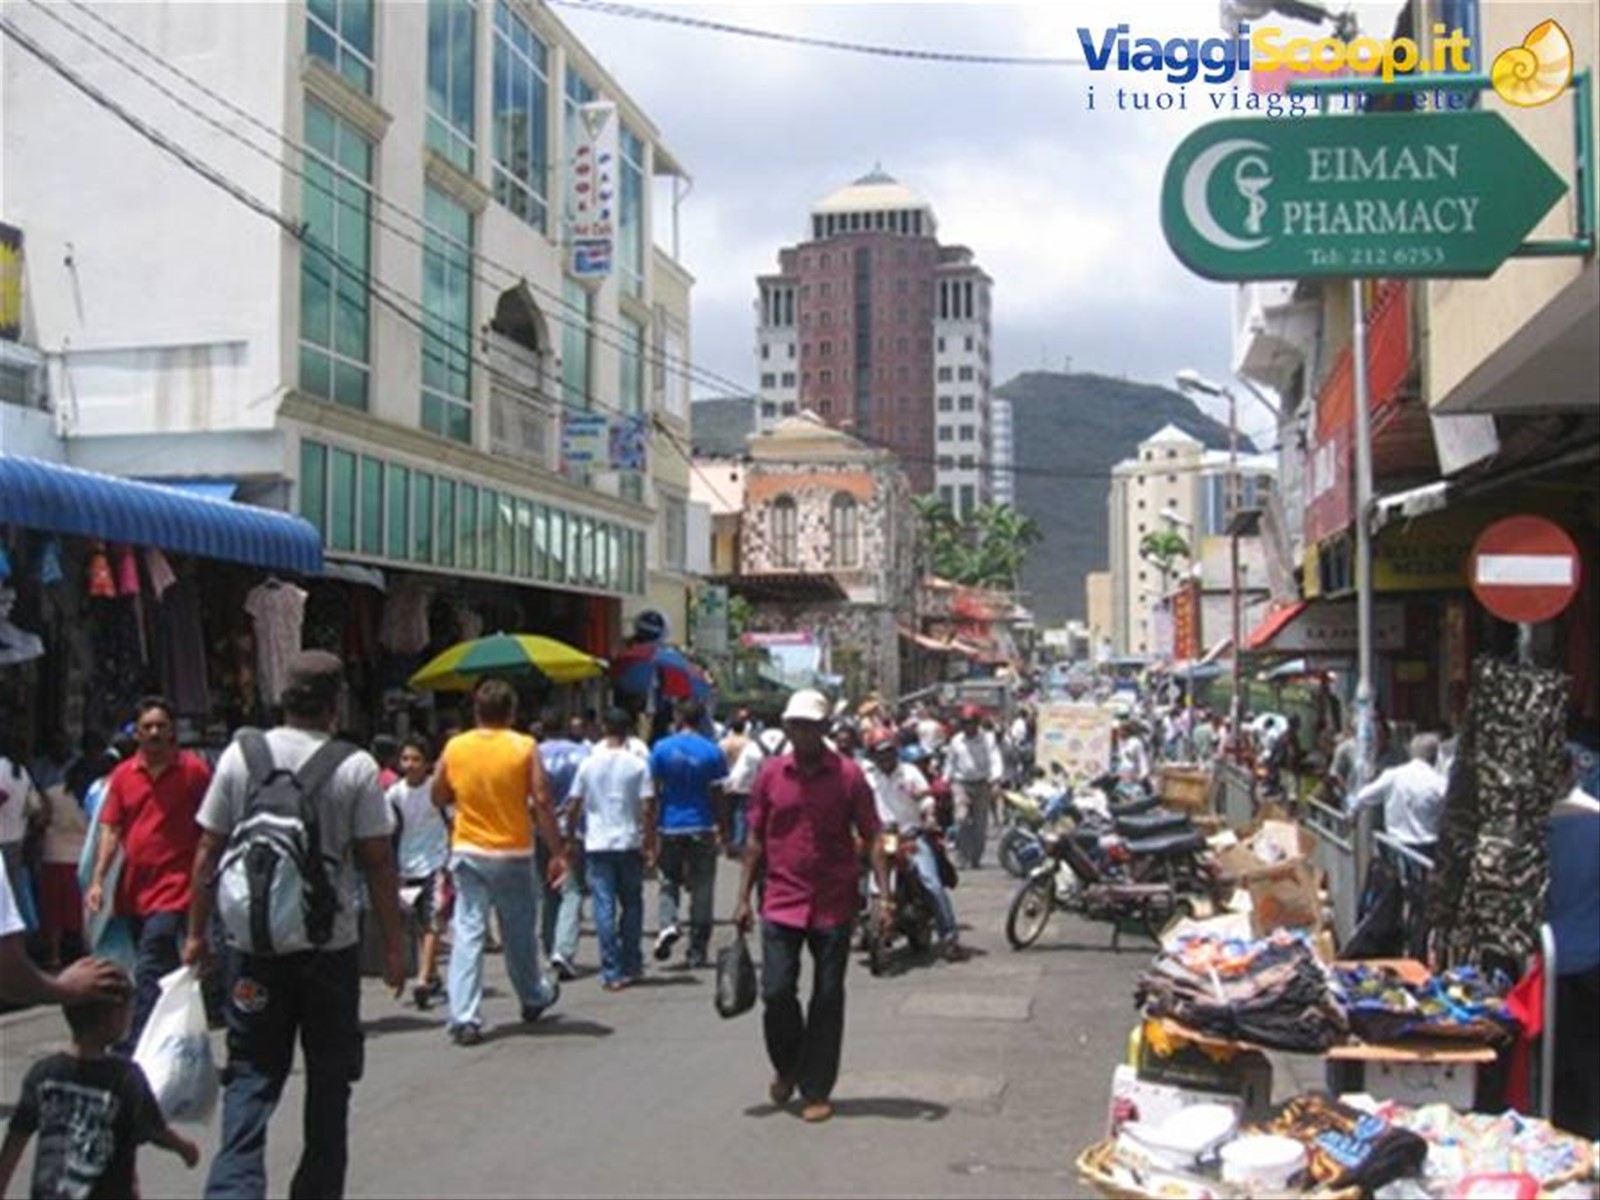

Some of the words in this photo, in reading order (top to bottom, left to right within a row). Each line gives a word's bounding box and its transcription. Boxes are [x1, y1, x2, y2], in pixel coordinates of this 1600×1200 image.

[1307, 145, 1458, 181] EIMAN
[1283, 197, 1479, 235] PHARMACY
[1350, 248, 1387, 265] 212
